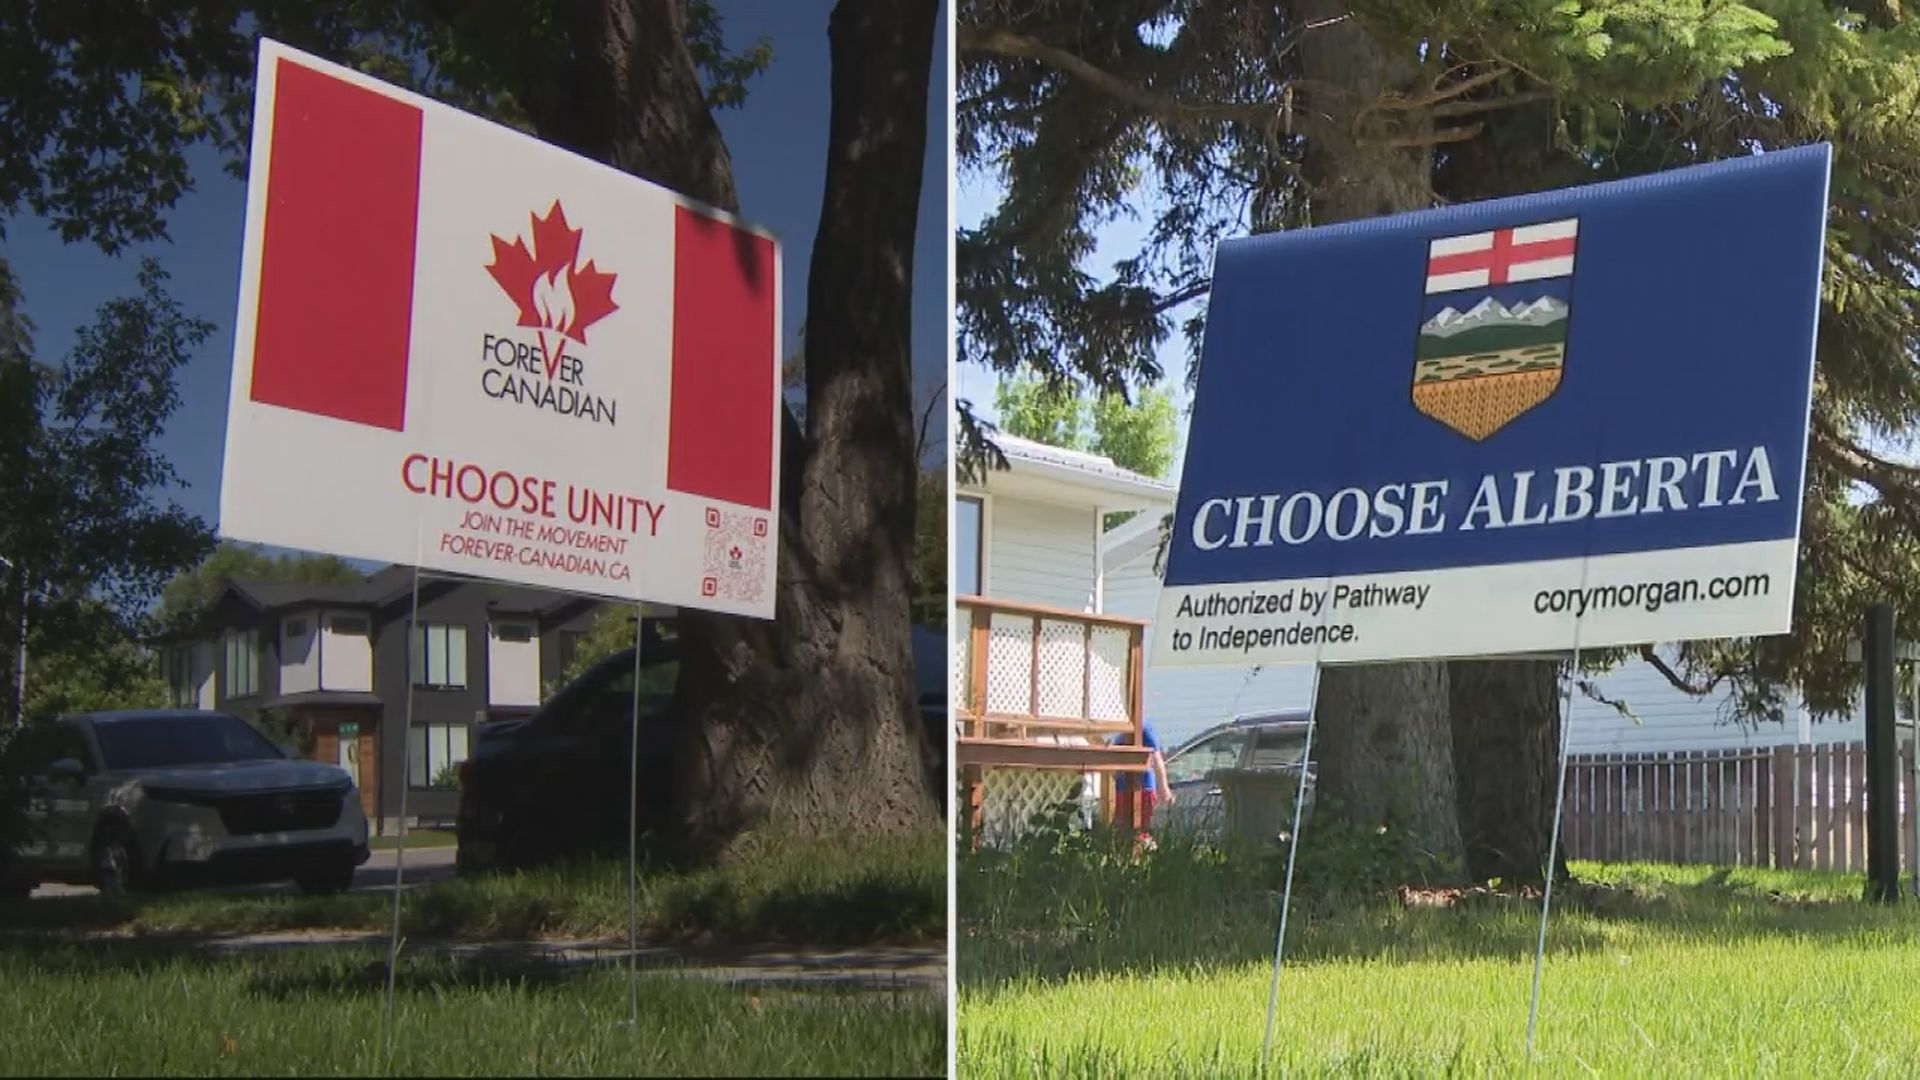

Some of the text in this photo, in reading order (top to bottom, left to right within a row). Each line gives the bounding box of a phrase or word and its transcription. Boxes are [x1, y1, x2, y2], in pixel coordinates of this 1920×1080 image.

[483, 330, 584, 386] FOREVER
[482, 368, 616, 426] CANADIAN
[402, 454, 665, 536] CHOOSE UNITY
[1192, 445, 1780, 550] CHOOSE ALBERTA
[460, 511, 628, 555] JOIN THE MOVEMENT
[441, 534, 630, 581] FOREVER-CANADIAN.CA
[1177, 581, 1430, 618] Authorized by Pathway
[1533, 573, 1770, 615] corymorgan.com
[1172, 622, 1359, 653] to Independence.
